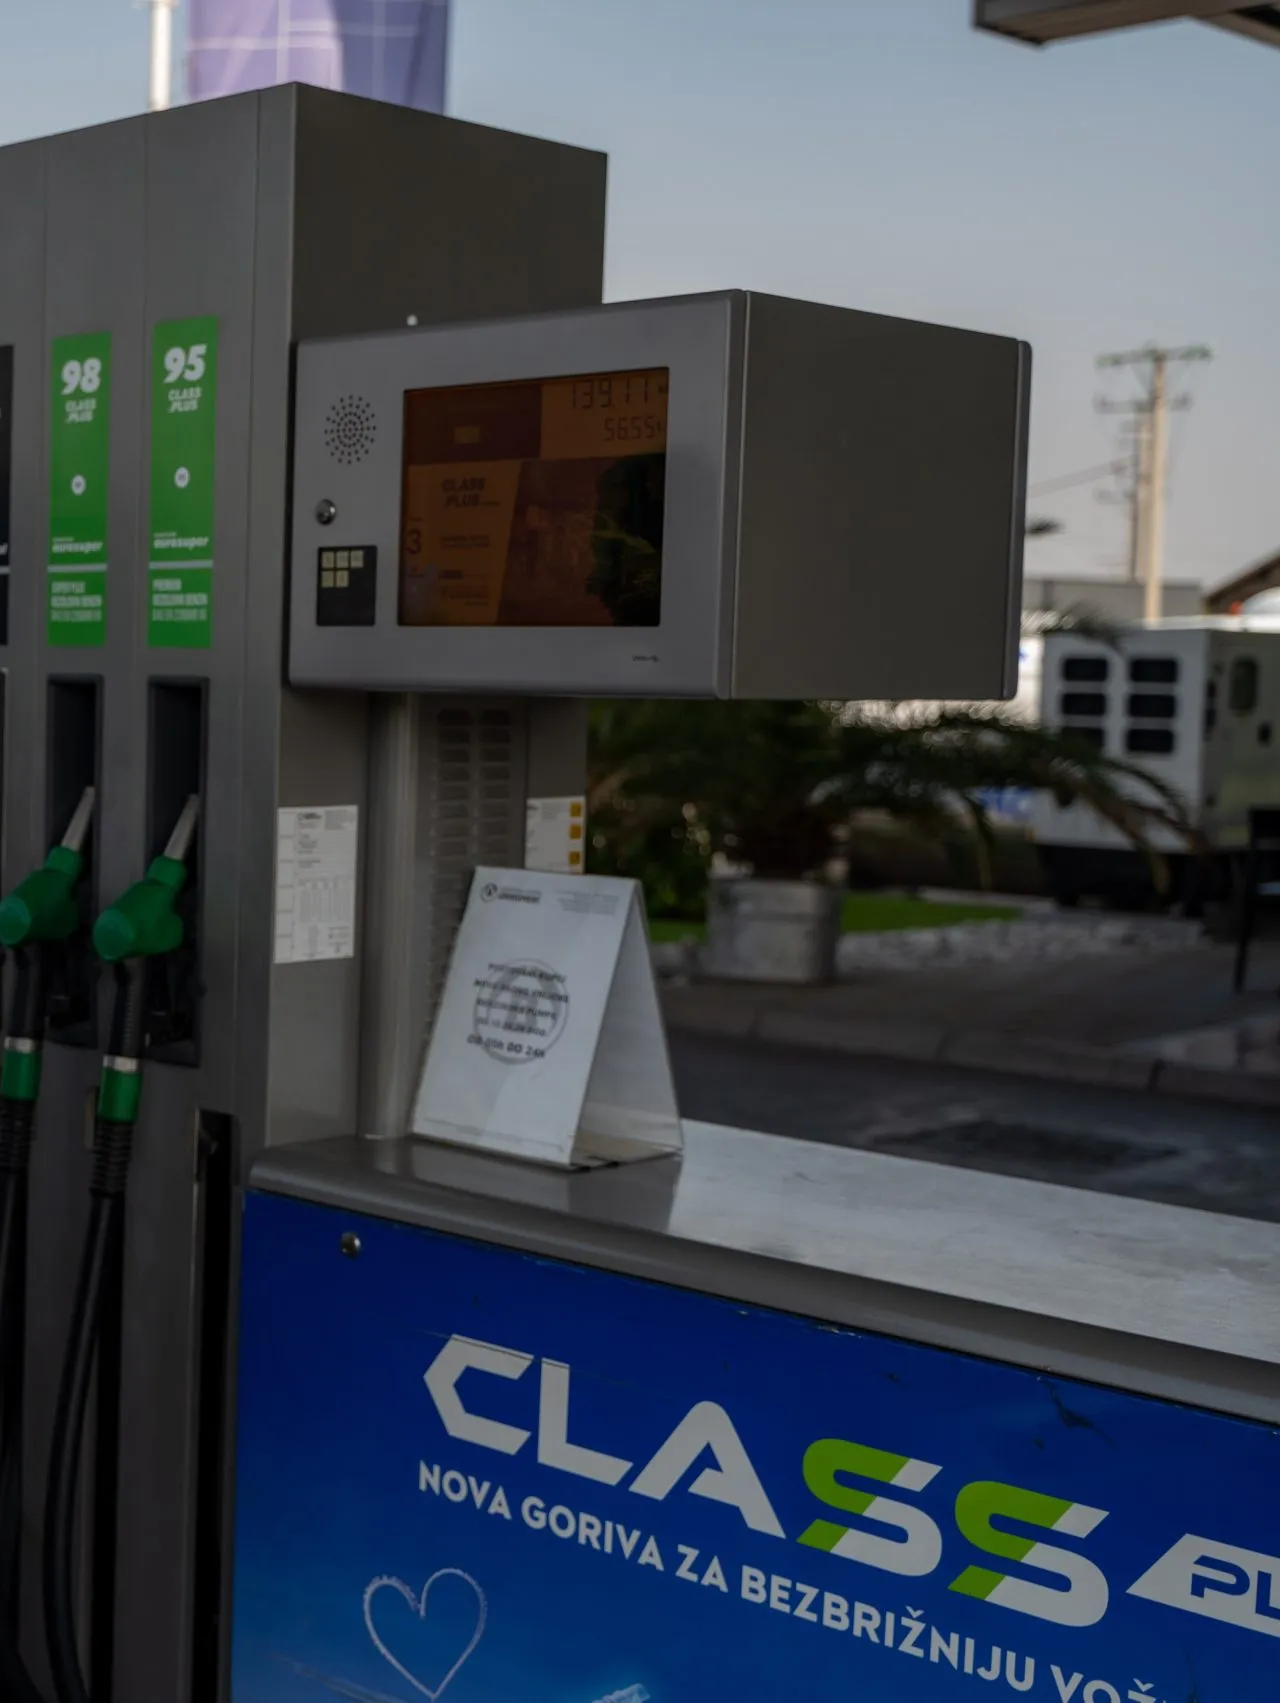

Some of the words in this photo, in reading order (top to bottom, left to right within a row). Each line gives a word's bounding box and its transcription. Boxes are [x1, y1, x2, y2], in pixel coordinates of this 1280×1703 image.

[61, 357, 102, 396] 98
[164, 344, 207, 383] 95
[168, 386, 202, 401] CLASS
[423, 1333, 1110, 1627] CLASS
[419, 1460, 512, 1520] NOVA
[521, 1496, 664, 1571] GORIVA
[675, 1544, 729, 1592] ZA
[740, 1565, 1036, 1692] BEZBRIŽNIJU
